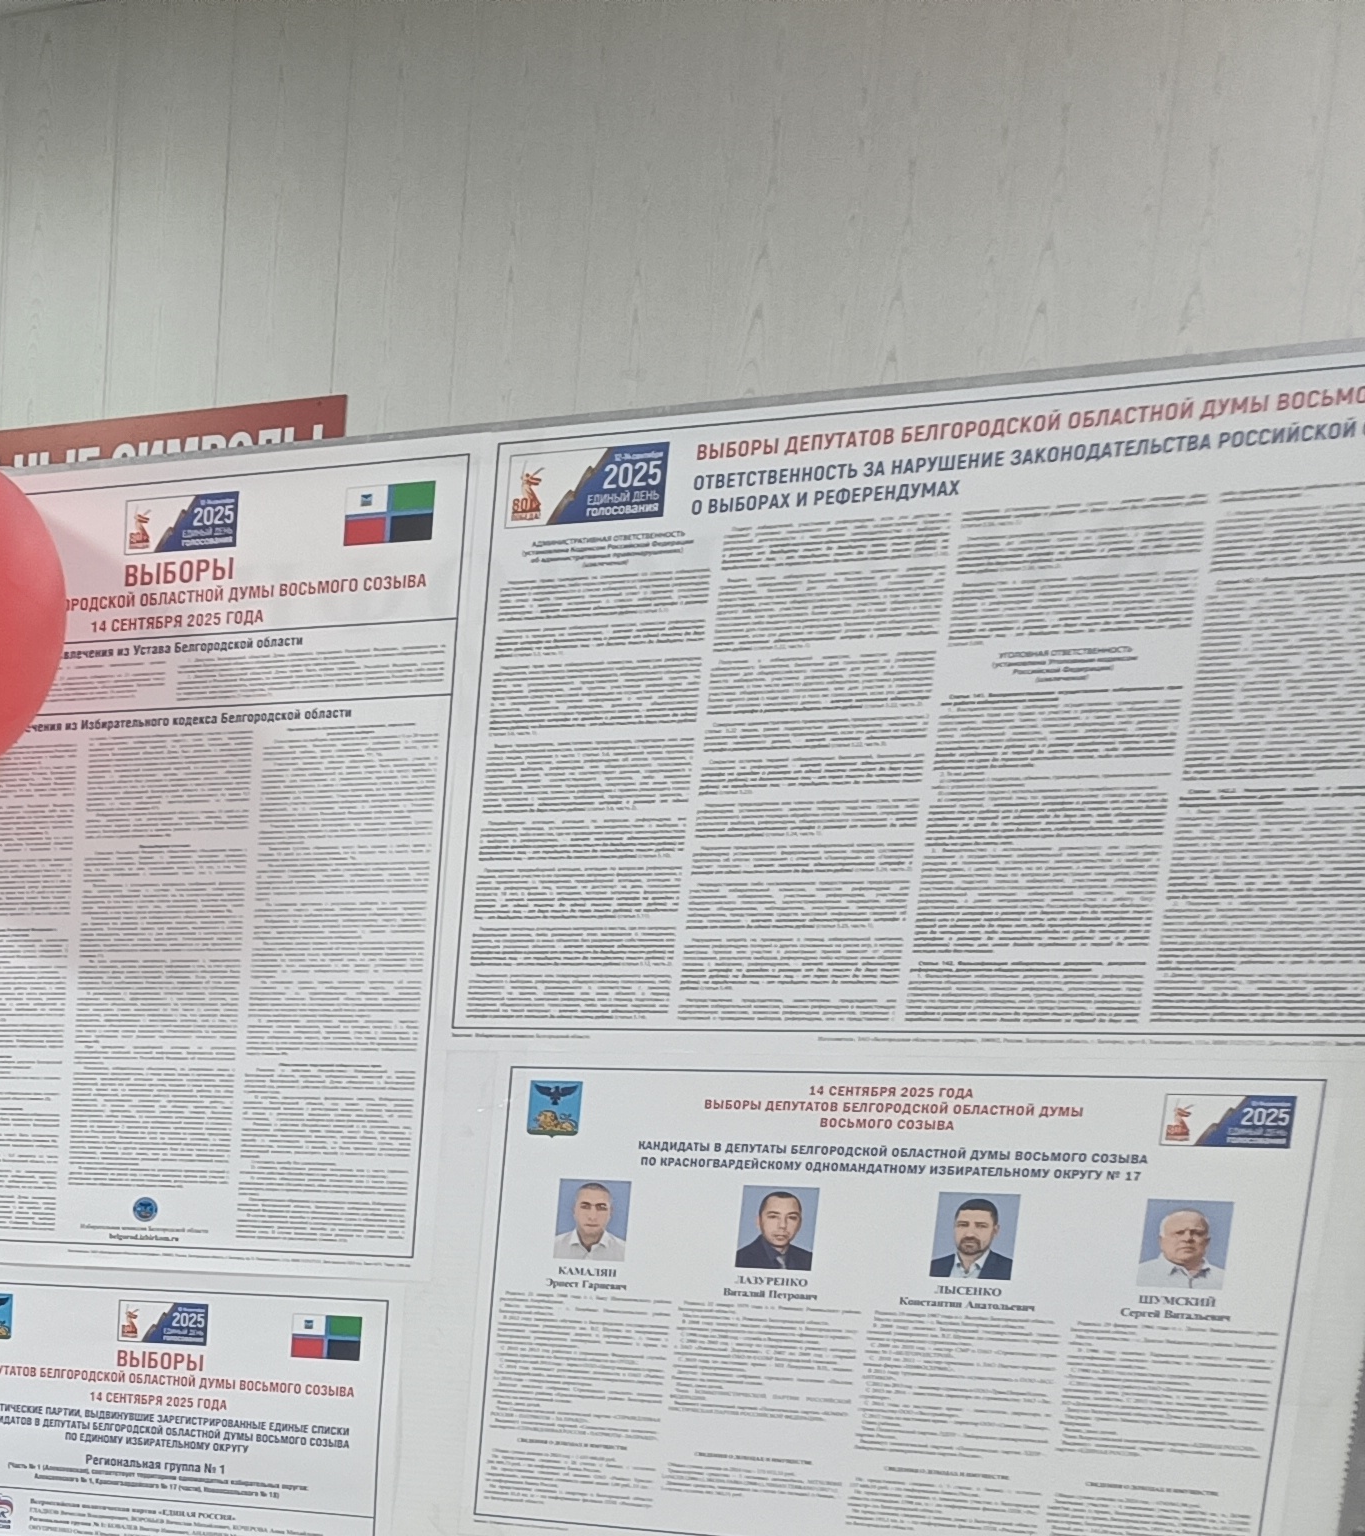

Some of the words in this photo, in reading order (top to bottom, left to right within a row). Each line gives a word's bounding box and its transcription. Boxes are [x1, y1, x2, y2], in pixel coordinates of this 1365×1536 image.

[696, 437, 779, 461] ВЫБОРЫ
[783, 427, 894, 455] ДЕПУТАТОВ
[901, 408, 1061, 444] БЕЛГОРОДСКОЙ
[1067, 397, 1194, 429] ОБЛАСТНОЙ
[1198, 394, 1269, 421] ДУМЫ
[1276, 382, 1365, 411] ВОСЬМО
[693, 462, 858, 491] ОТВЕТСТВЕННОСТЬ
[863, 460, 885, 478] ЗА
[890, 450, 1005, 475] НАРУШЕНИЕ
[1010, 433, 1211, 466] ЗАКОНОДАТЕЛЬСТВА
[1217, 418, 1357, 449] РОССИЙСКОЙ
[602, 461, 662, 489] 2025
[586, 490, 630, 506] ЕДИНЫЙ
[631, 489, 660, 501] ДЕНЬ
[691, 499, 702, 516] О
[707, 492, 790, 514] ВЫБОРАХ
[796, 491, 808, 507] И
[813, 479, 960, 506] РЕФЕРЕНДУМАХ
[192, 505, 234, 526] 2025
[124, 557, 234, 587] ВЫБОРЫ
[66, 591, 135, 612] РОДСКОЙ
[139, 584, 224, 607] ОБЛАСТНОЙ
[227, 584, 275, 603] ДУМЫ
[279, 577, 358, 597] ВОСЬМОГО
[363, 573, 426, 592] СОЗЫВА
[91, 620, 107, 633] 14
[111, 614, 183, 632] СЕНТЯБРЯ
[186, 611, 221, 628] 2025
[226, 609, 263, 626] ГОДА
[63, 649, 114, 660] влечения
[116, 647, 130, 657] из
[133, 644, 171, 656] Устава
[174, 637, 253, 654] Белгородской
[256, 635, 303, 649] области
[26, 722, 62, 733] чения
[64, 721, 78, 731] из
[80, 717, 170, 731] Избирательного
[172, 715, 218, 727] кодекса
[220, 708, 301, 725] Белгородской
[304, 707, 352, 720] области
[809, 1085, 824, 1096] 14
[828, 1085, 896, 1097] СЕНТЯБРЯ
[900, 1086, 934, 1098] 2025
[938, 1087, 973, 1102] ГОДА
[704, 1098, 762, 1110] ВЫБОРЫ
[764, 1100, 838, 1112] ДЕПУТАТОВ
[842, 1101, 948, 1115] БЕЛГОРОДСКОЙ
[952, 1102, 1035, 1116] ОБЛАСТНОЙ
[1038, 1105, 1083, 1118] ДУМЫ
[1240, 1107, 1291, 1126] 2025
[819, 1117, 893, 1130] ВОСЬМОГО
[896, 1118, 954, 1131] СОЗЫВА
[638, 1140, 710, 1153] КАНДИДАТЫ
[713, 1142, 722, 1153] В
[724, 1142, 787, 1154] ДЕПУТАТЫ
[790, 1144, 887, 1158] БЕЛГОРОДСКОЙ
[891, 1146, 966, 1159] ОБЛАСТНОЙ
[969, 1149, 1011, 1161] ДУМЫ
[1014, 1150, 1087, 1163] ВОСЬМОГО
[1091, 1152, 1148, 1164] СОЗЫВА
[640, 1156, 656, 1166] ПО
[659, 1156, 802, 1171] КРАСНОГВАРДЕЙСКОМУ
[804, 1161, 926, 1175] ОДНОМАНДАТНОМУ
[929, 1165, 1050, 1179] ИЗБИРАТЕЛЬНОМУ
[1053, 1168, 1103, 1180] ОКРУГУ
[1125, 1171, 1141, 1181] 17
[734, 1275, 808, 1287] ЛАЗУРЕНКО
[934, 1284, 1002, 1297] ЛЫСЕНКО
[1138, 1294, 1216, 1307] ШУМСКИЙ
[171, 1312, 205, 1328] 2025
[117, 1350, 204, 1372] ВЫБОРЫ
[39, 1367, 126, 1383] БЕЛГОРОДСКОЙ
[128, 1372, 196, 1388] ОБЛАСТНОЙ
[198, 1377, 236, 1390] ДУМЫ
[239, 1379, 301, 1395] ВОСЬМОГО
[304, 1383, 354, 1398] СОЗЫВА
[90, 1391, 102, 1402] 14
[105, 1391, 163, 1406] СЕНТЯБРЯ
[166, 1395, 194, 1408] 2025
[197, 1397, 227, 1412] ГОДА
[64, 1431, 77, 1441] ПО
[79, 1432, 123, 1444] ЕДИНОМУ
[125, 1436, 210, 1451] ИЗБИРАТЕЛЬНОМУ
[212, 1442, 249, 1454] ОКРУГУ
[85, 1453, 161, 1470] Региональная
[164, 1461, 201, 1474] группа
[203, 1462, 216, 1474] №
[219, 1464, 225, 1475] 1
